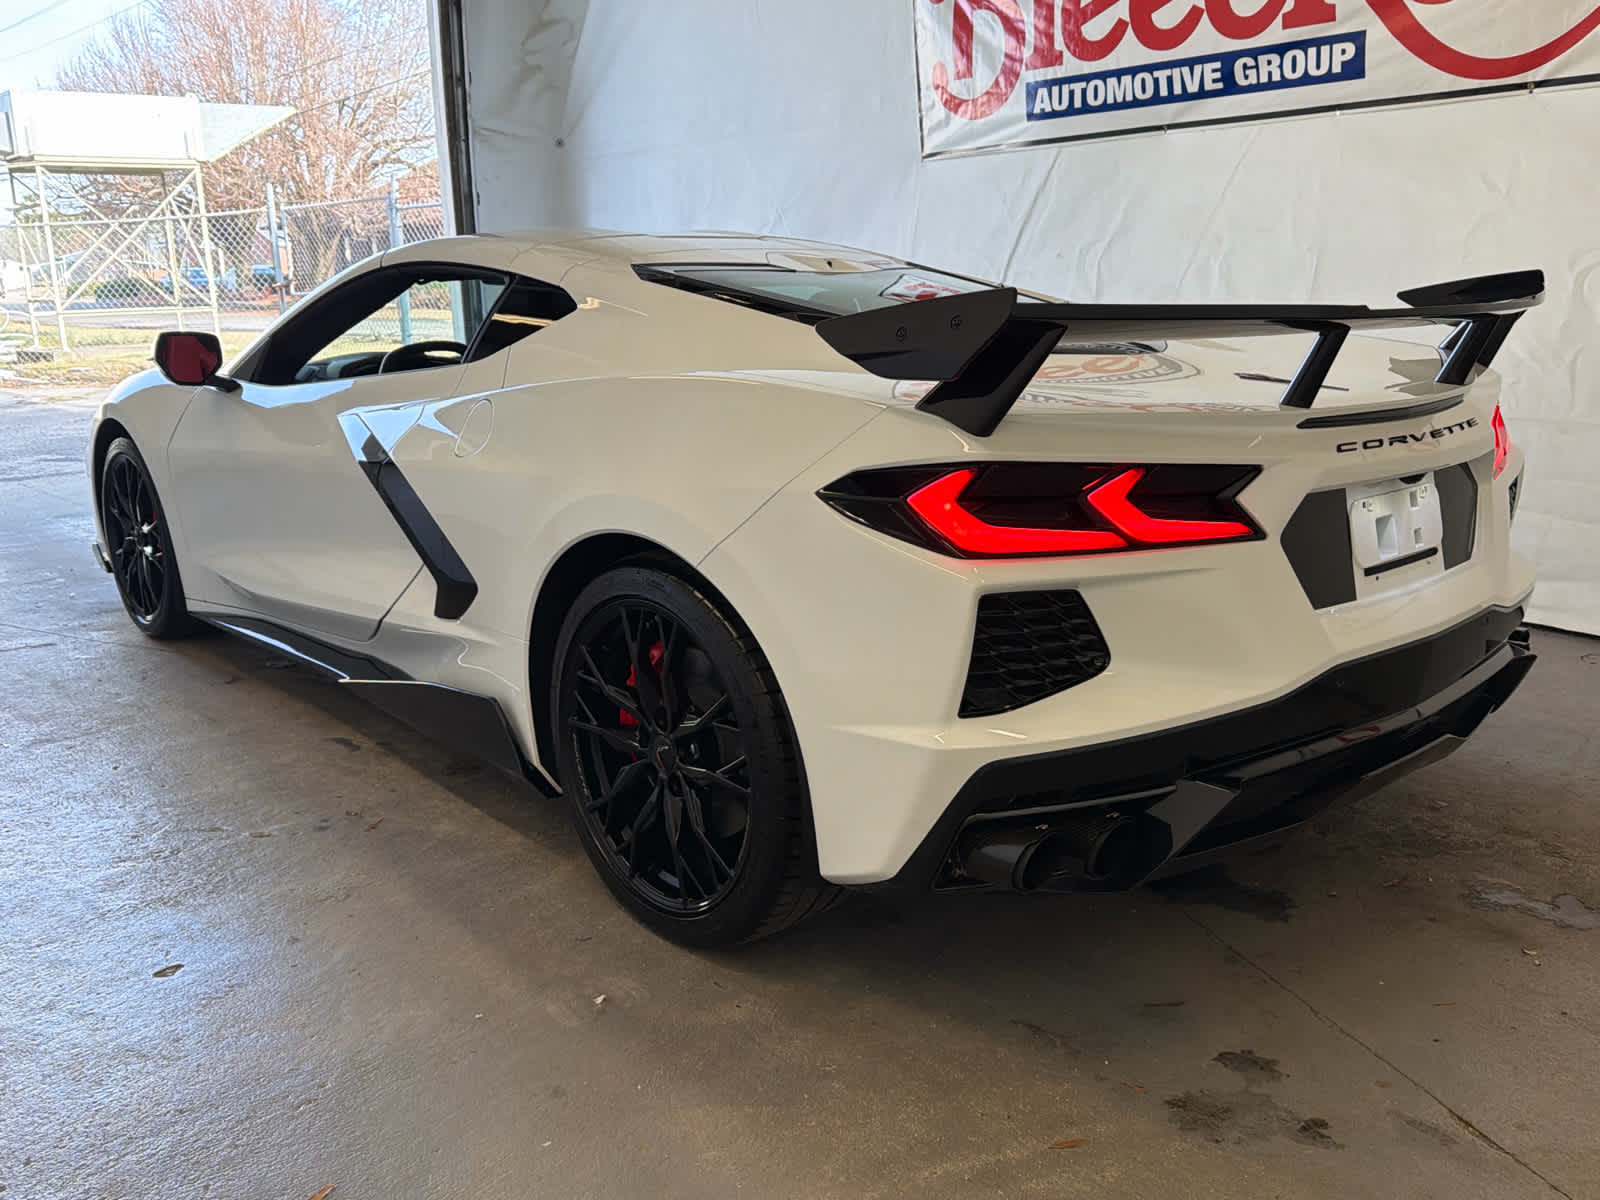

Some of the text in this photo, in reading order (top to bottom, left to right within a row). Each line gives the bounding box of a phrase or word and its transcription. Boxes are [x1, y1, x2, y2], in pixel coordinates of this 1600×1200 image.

[1032, 42, 1356, 114] AUTOMOTIVE GROUP
[1336, 417, 1479, 453] CORVETTE
